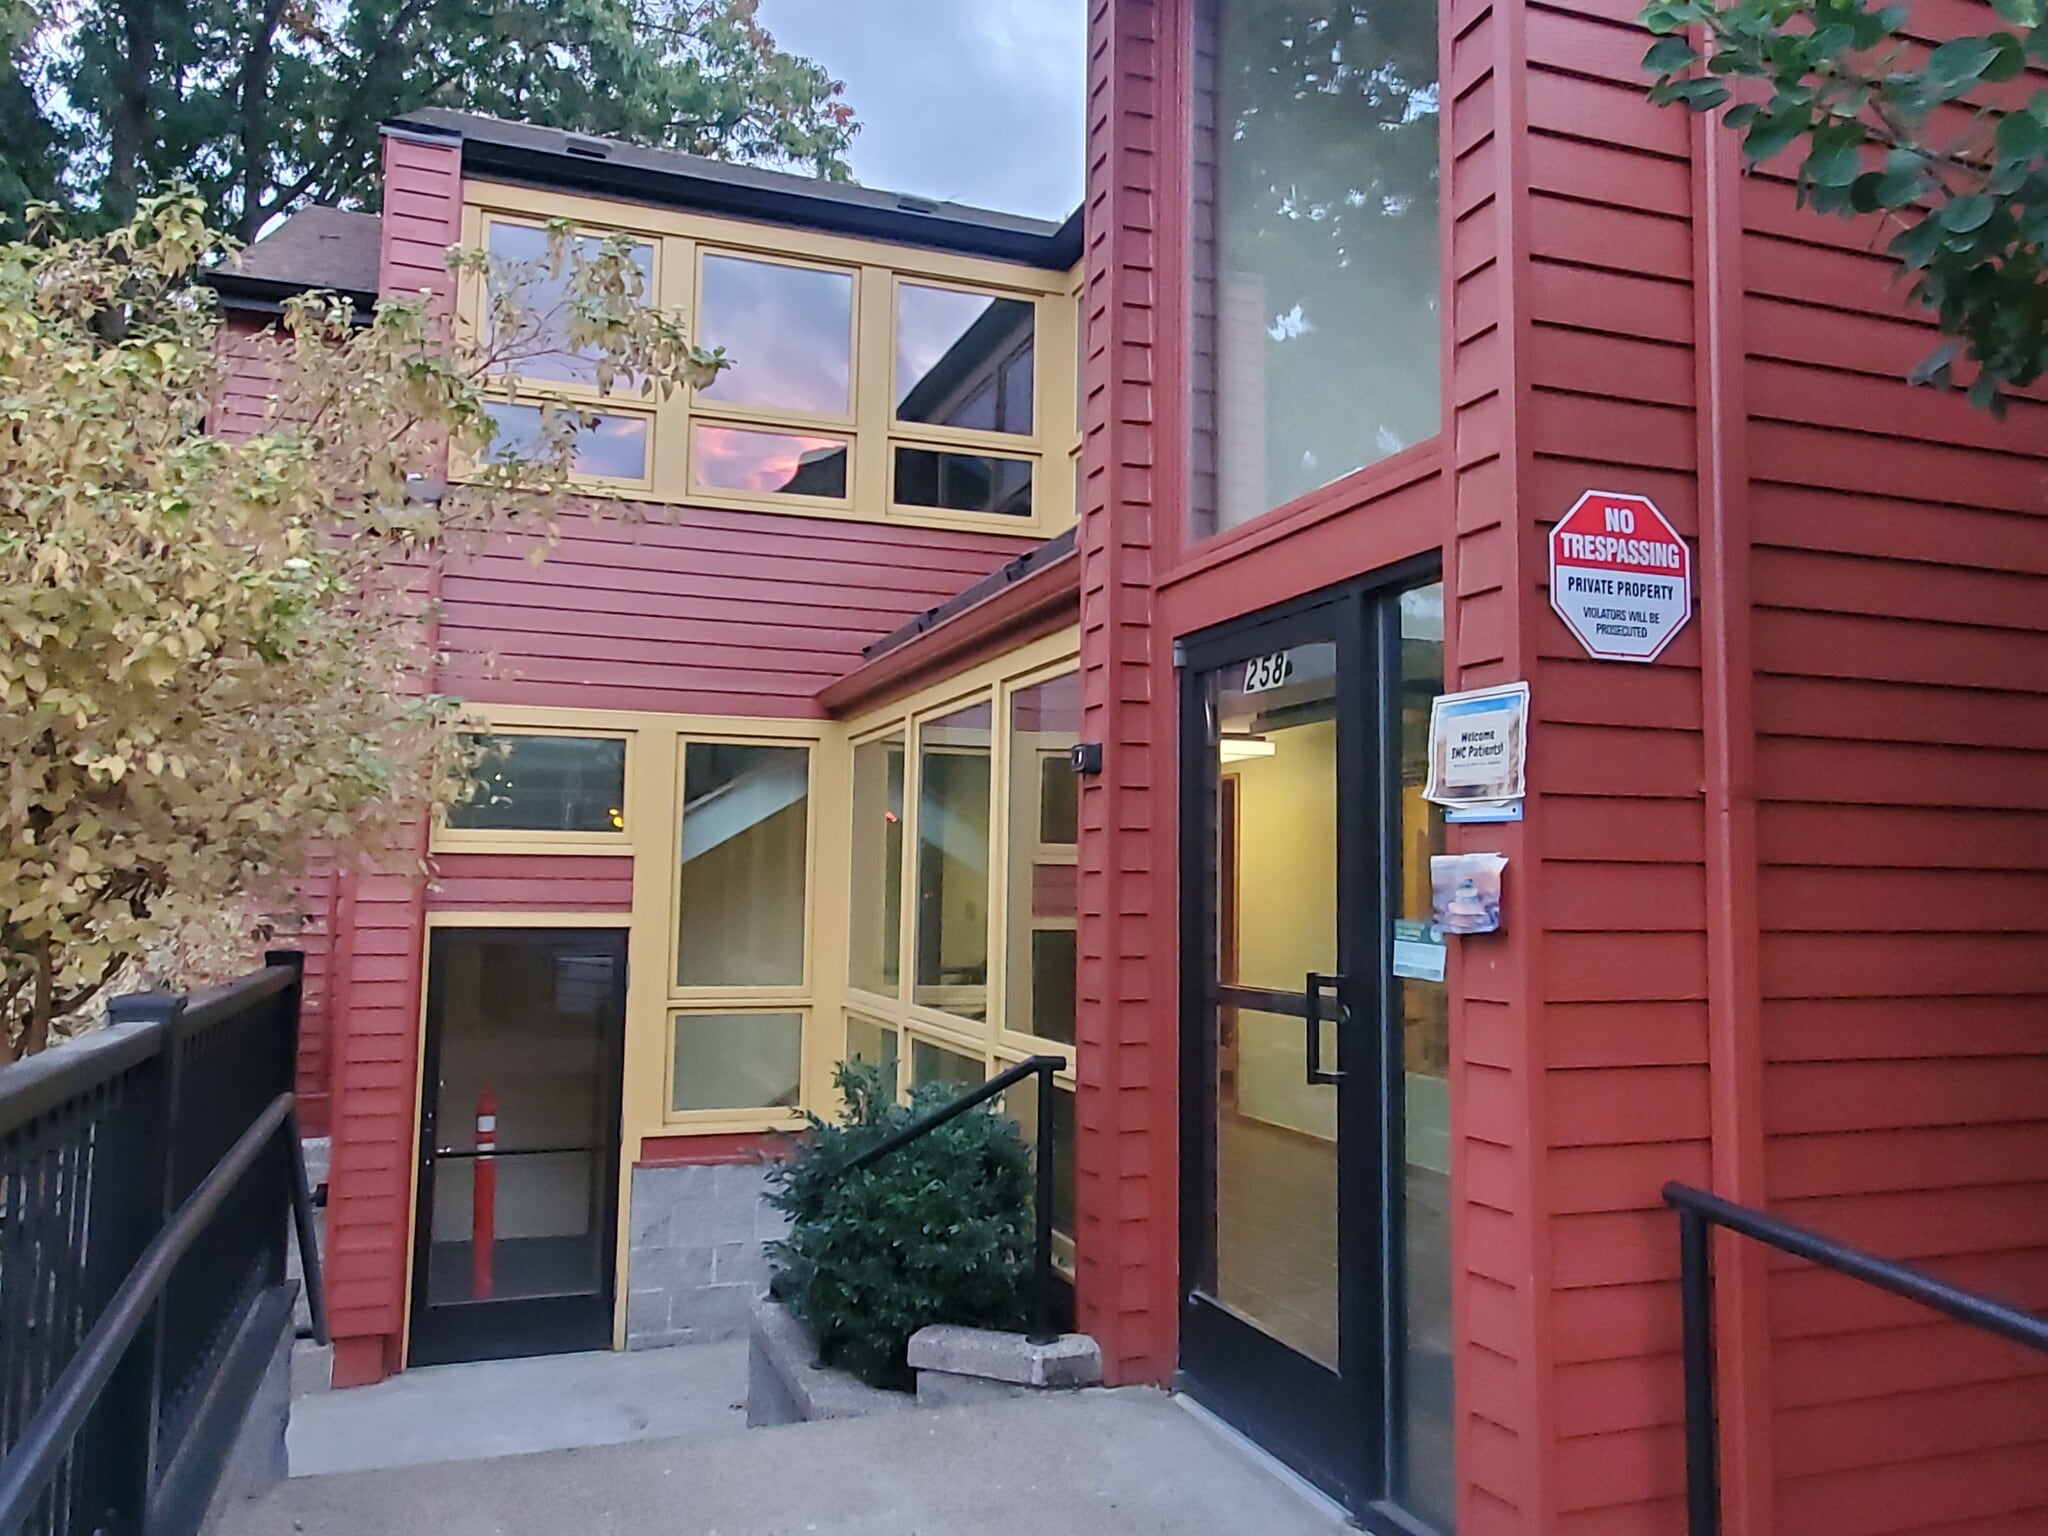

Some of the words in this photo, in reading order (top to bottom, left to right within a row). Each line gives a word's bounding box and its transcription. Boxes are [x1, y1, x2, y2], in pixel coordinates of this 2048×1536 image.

[1604, 507, 1635, 534] NO
[1560, 532, 1680, 568] TRESPASSING
[1568, 576, 1613, 595] PRIVATE
[1617, 581, 1673, 601] PROPERTY
[1583, 606, 1626, 622] VIOLATORS
[1628, 611, 1648, 623] WILL
[1649, 613, 1660, 624] BE
[1596, 623, 1648, 638] PROSECUTED
[1246, 651, 1284, 691] 258
[1461, 730, 1495, 743] Welcome
